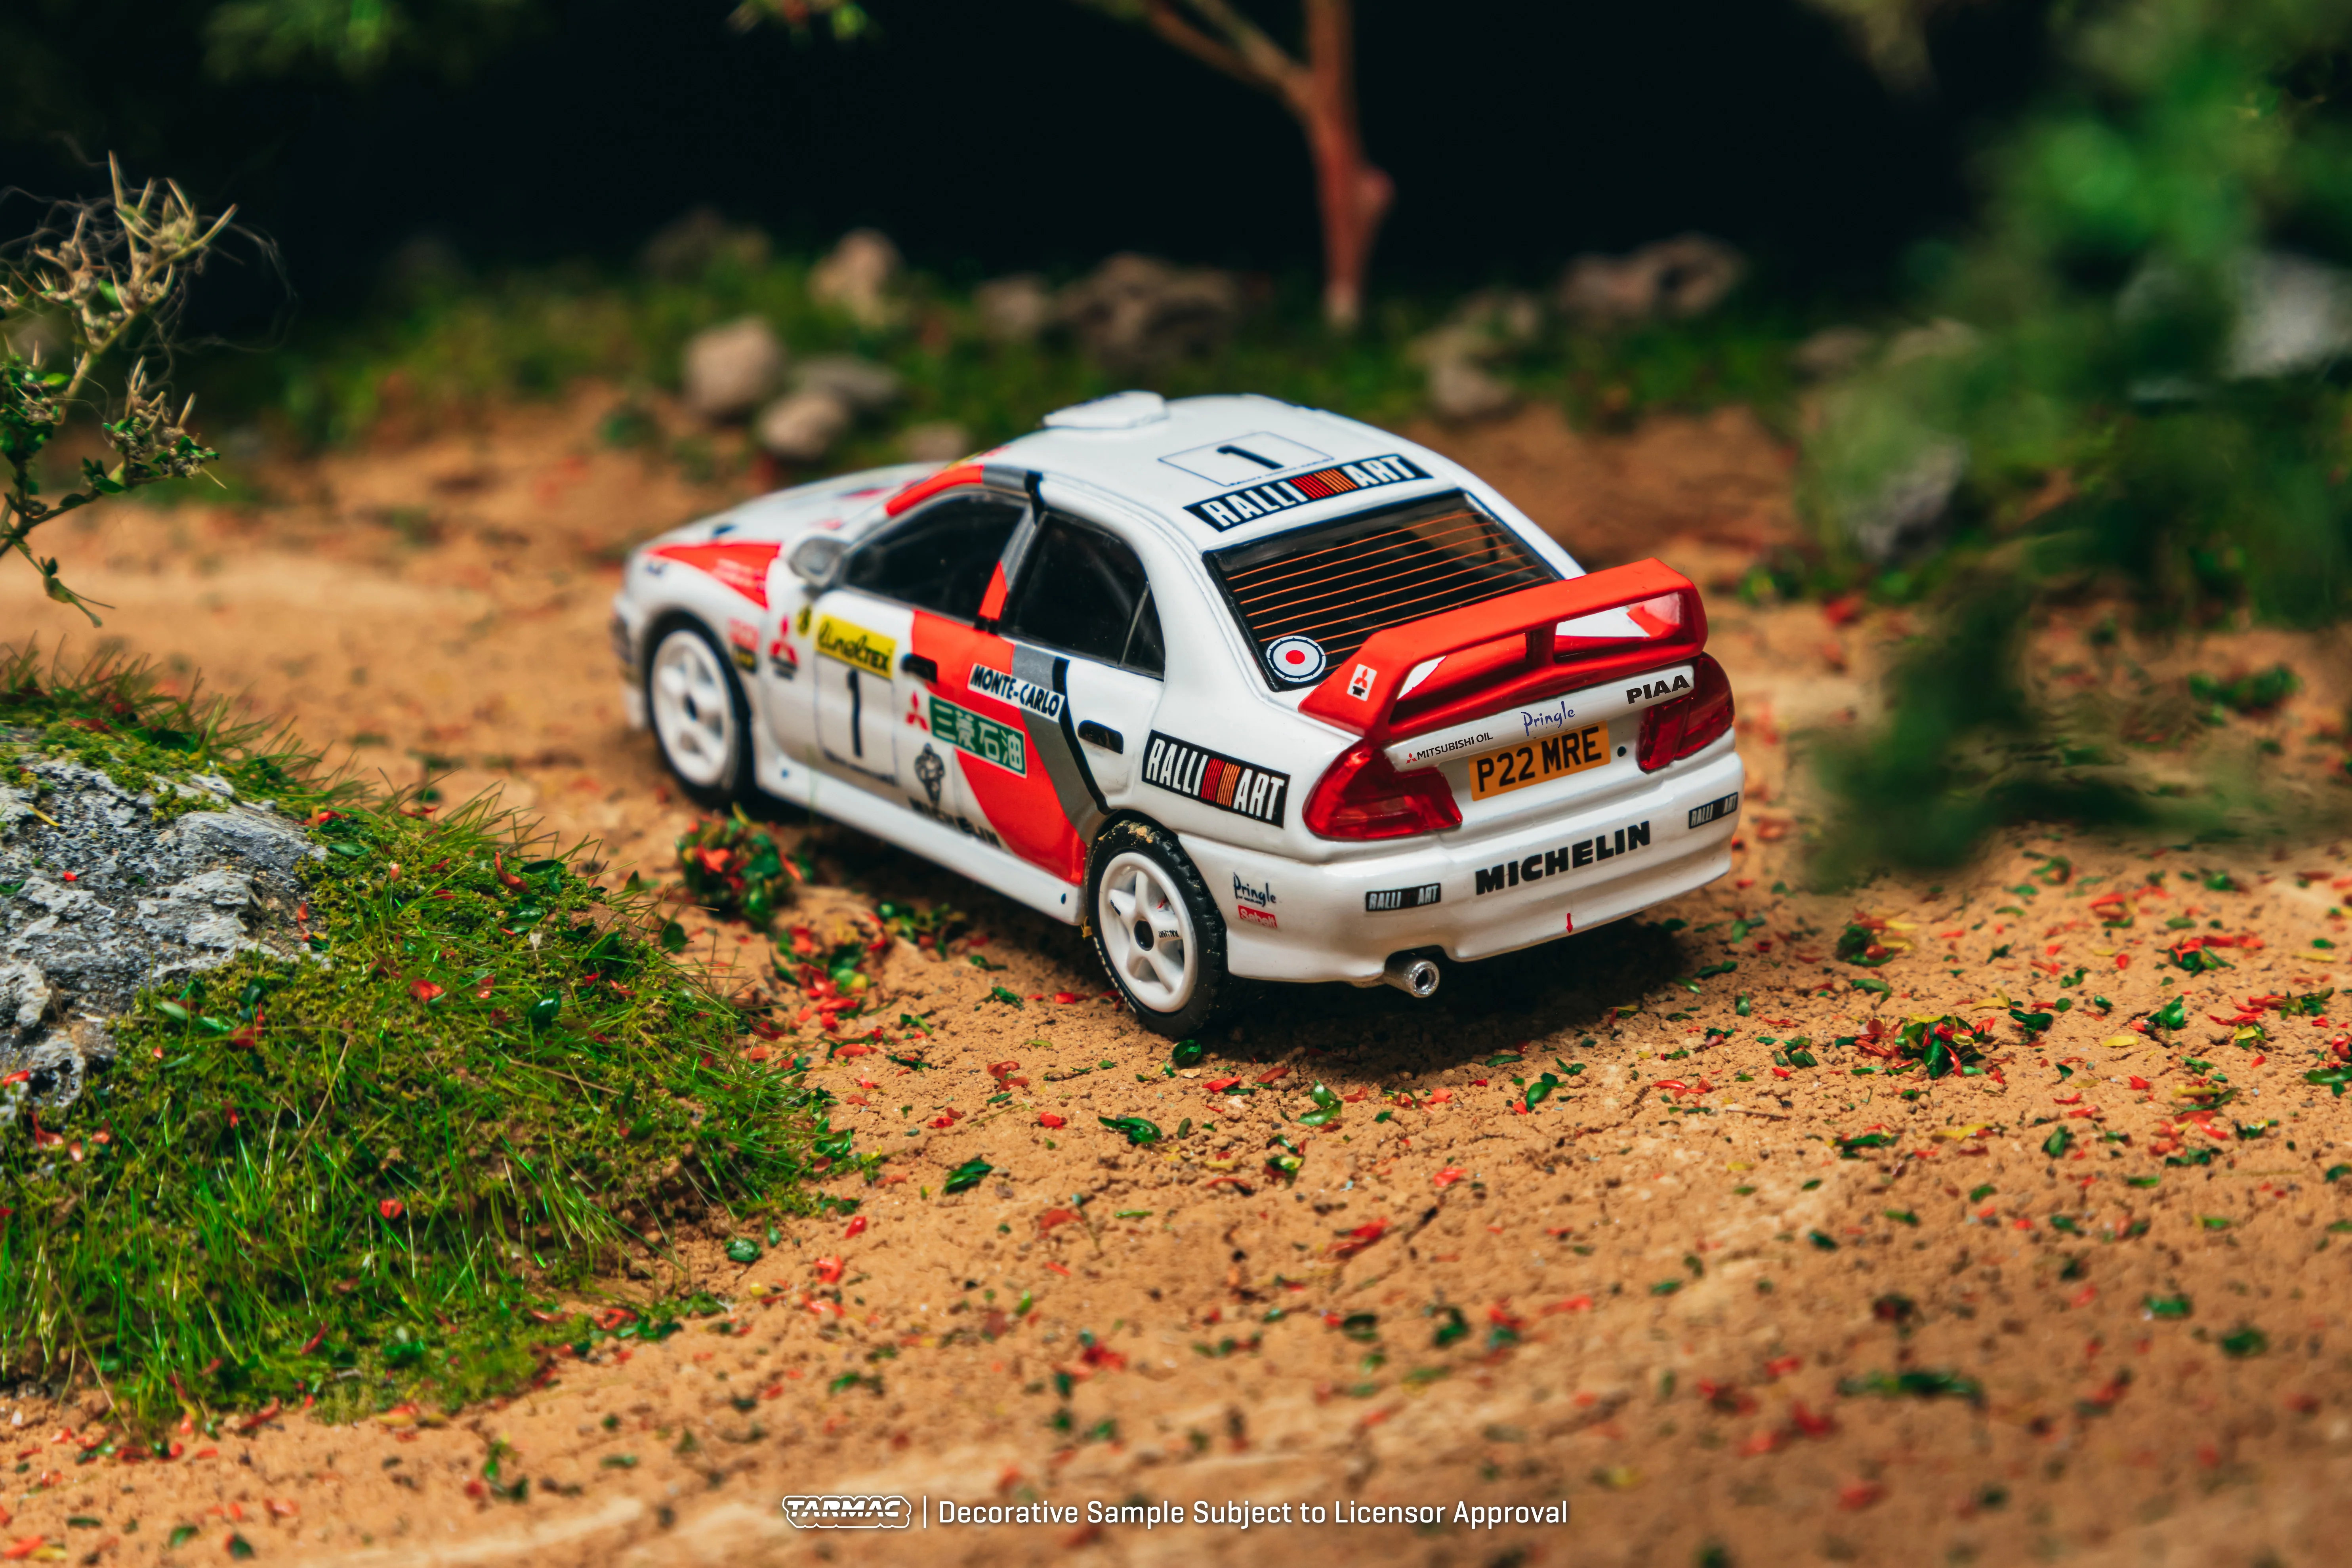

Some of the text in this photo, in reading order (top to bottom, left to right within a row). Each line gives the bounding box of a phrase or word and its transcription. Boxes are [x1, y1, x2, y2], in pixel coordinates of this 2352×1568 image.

[1216, 444, 1285, 470] 1
[970, 665, 1060, 717] MONTE-CARLO
[1626, 675, 1690, 705] PIAA
[848, 668, 862, 758] 1
[1521, 701, 1575, 736] Pringle
[935, 704, 1022, 770] 三菱石油
[1417, 732, 1493, 760] MITSUBISHI OIL
[1477, 726, 1602, 793] P22 MRE
[1475, 820, 1650, 895] MICHELIN
[1233, 872, 1276, 907] Pringle
